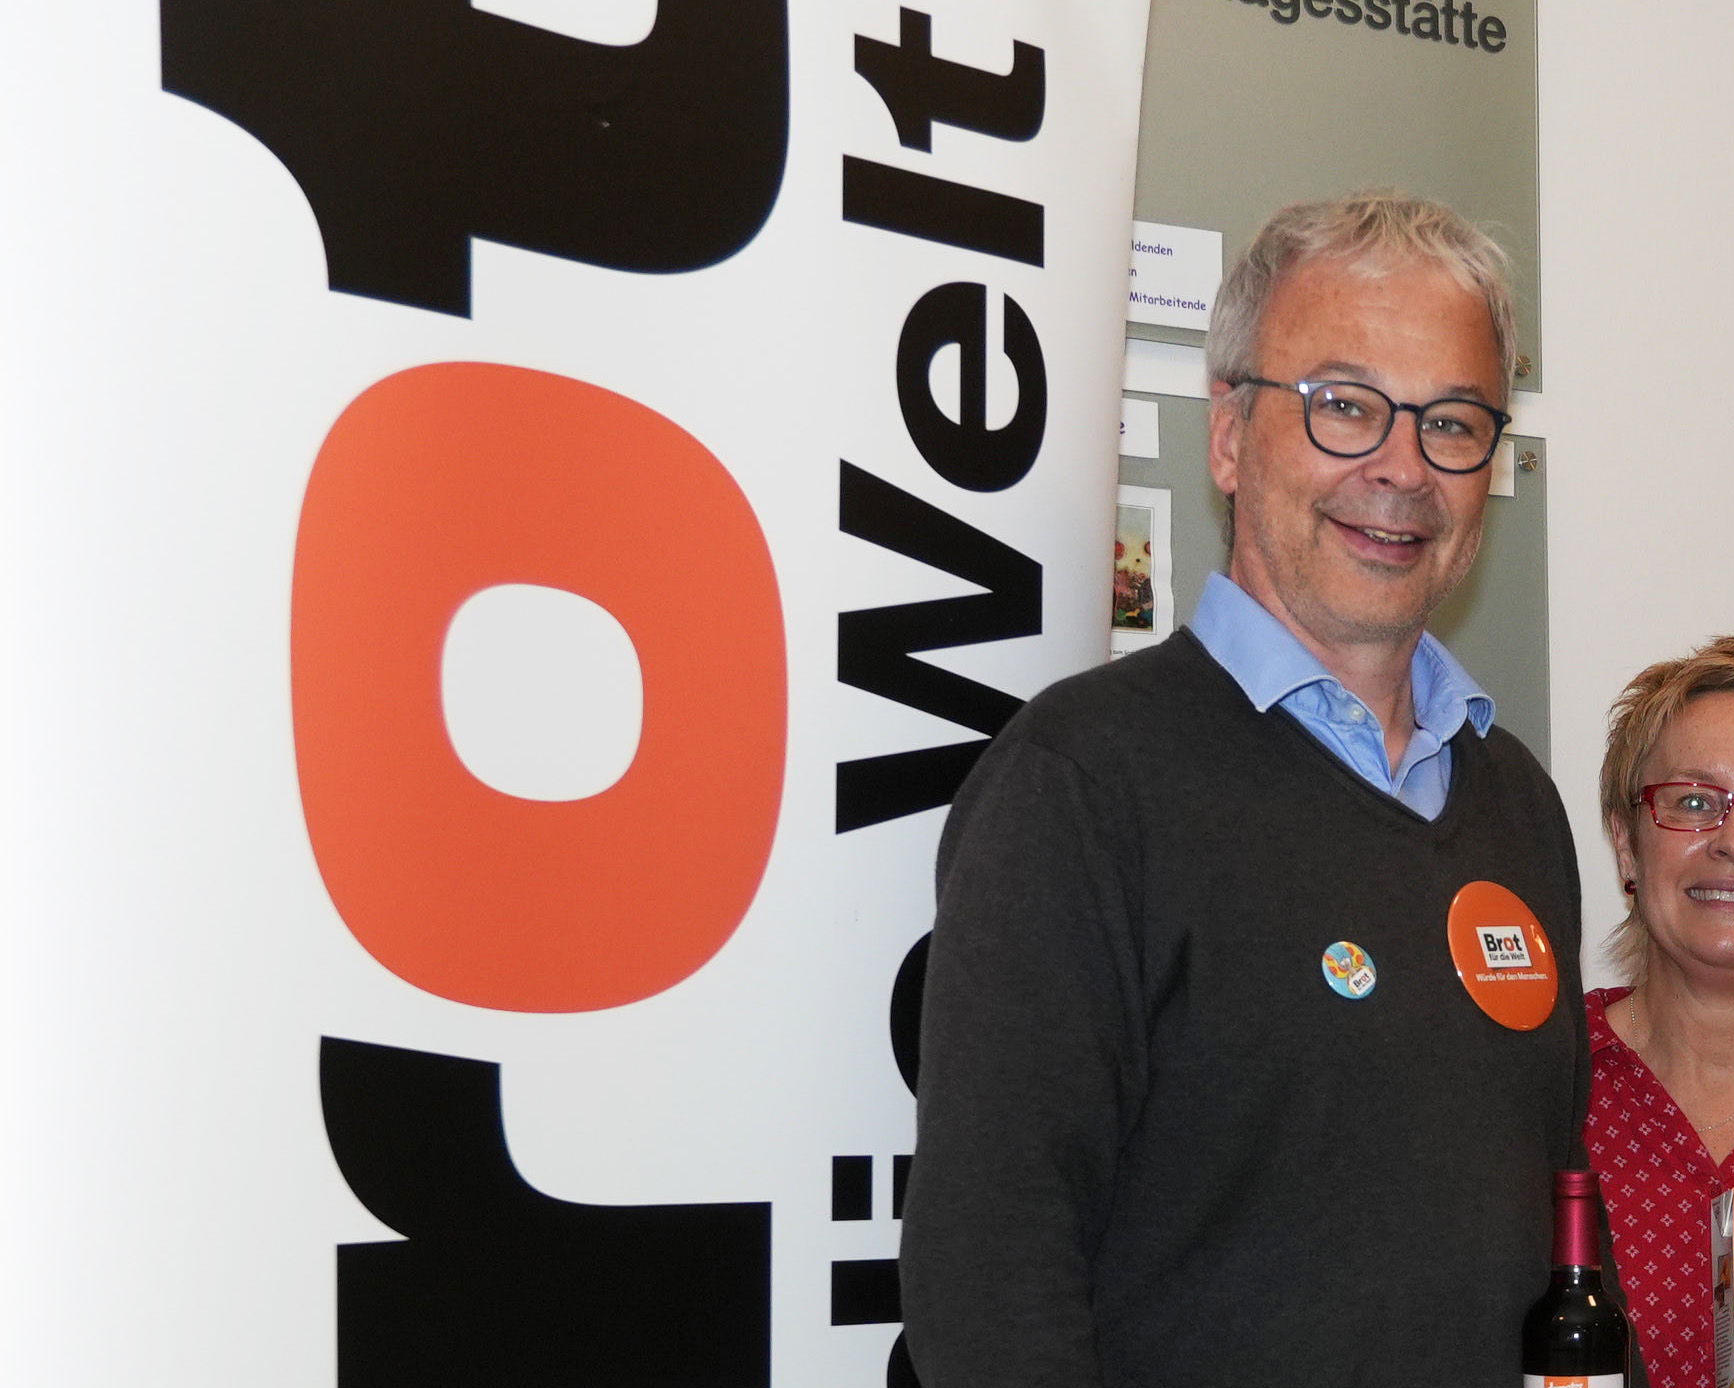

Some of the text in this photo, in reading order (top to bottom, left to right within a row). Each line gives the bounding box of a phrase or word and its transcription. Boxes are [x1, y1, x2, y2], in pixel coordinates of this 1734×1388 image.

[1129, 291, 1207, 311] Mitarbeitende
[835, 5, 1048, 834] Welt
[1483, 933, 1523, 952] Brot
